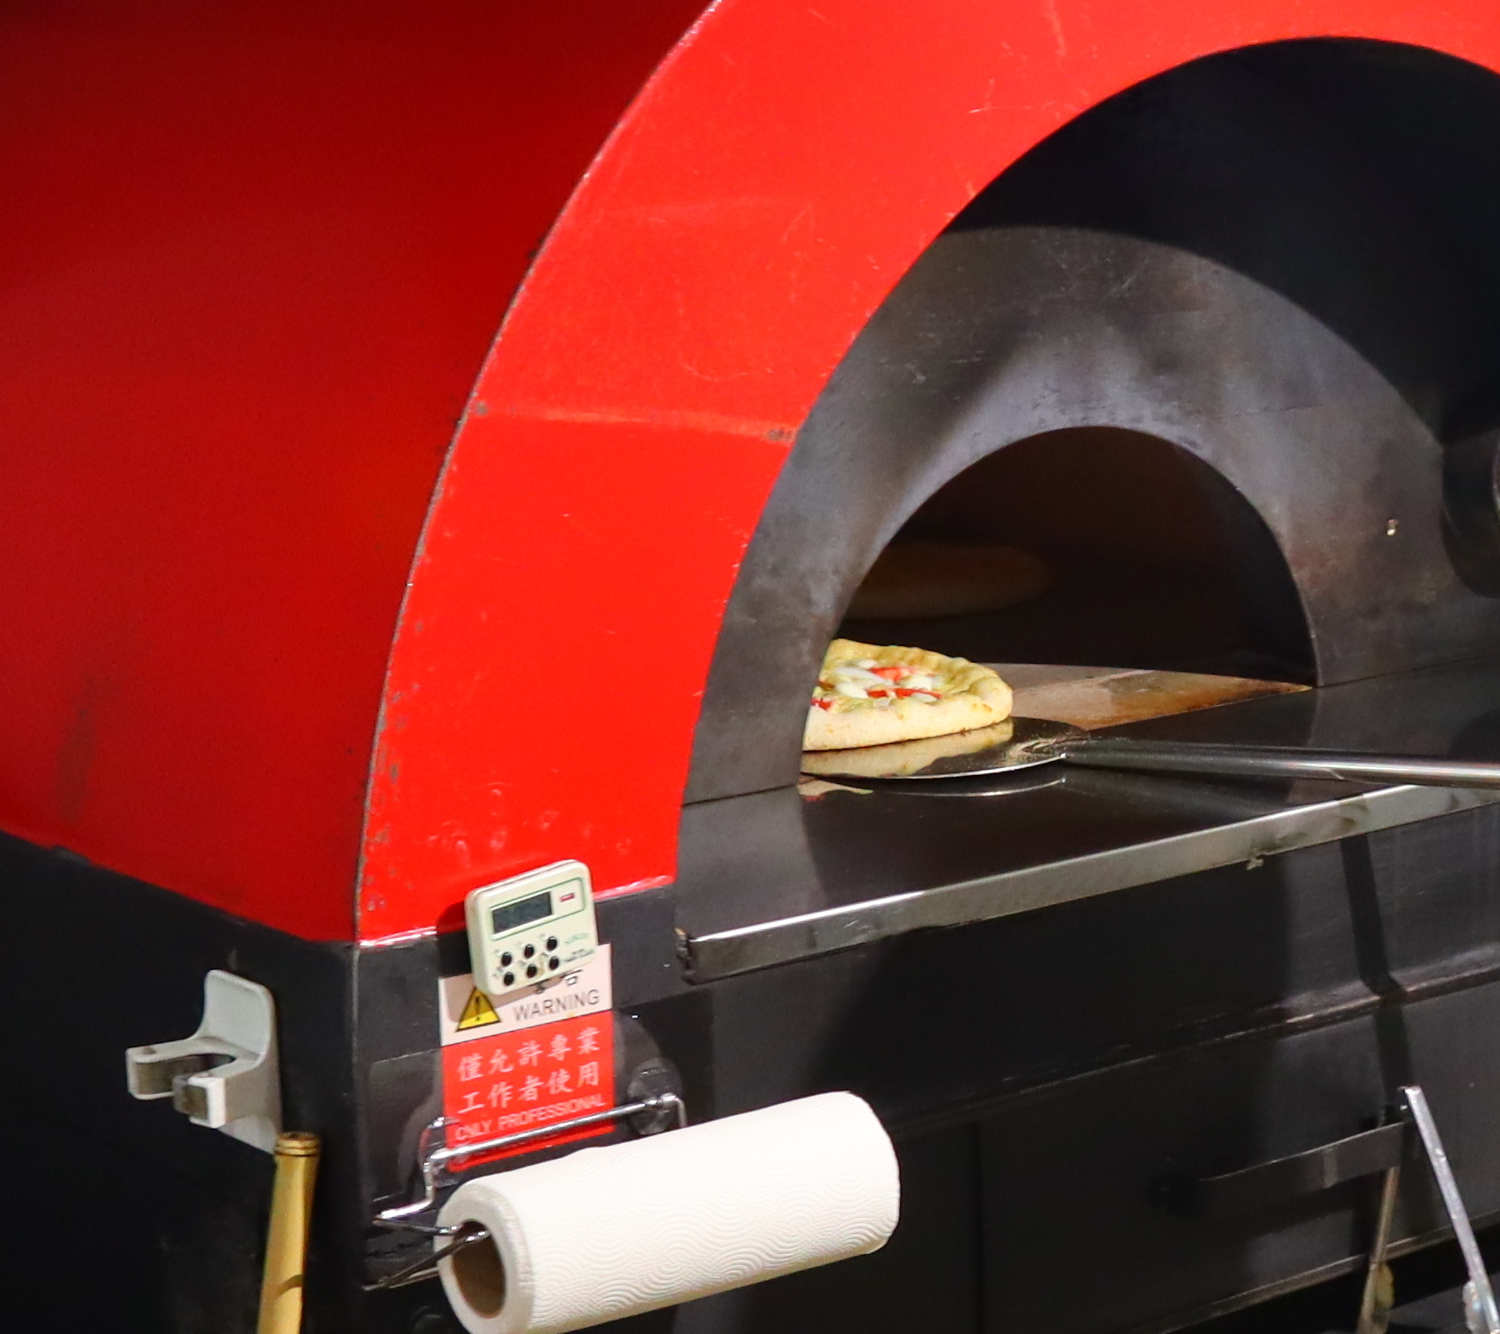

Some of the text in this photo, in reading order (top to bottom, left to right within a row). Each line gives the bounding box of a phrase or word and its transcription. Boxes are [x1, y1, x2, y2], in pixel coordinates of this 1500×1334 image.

[513, 988, 600, 1023] WARNING
[456, 1026, 601, 1083] 僅允許專業
[457, 1061, 600, 1115] 工作者使用
[455, 1093, 607, 1141] ONLY PROFESSIONAL
